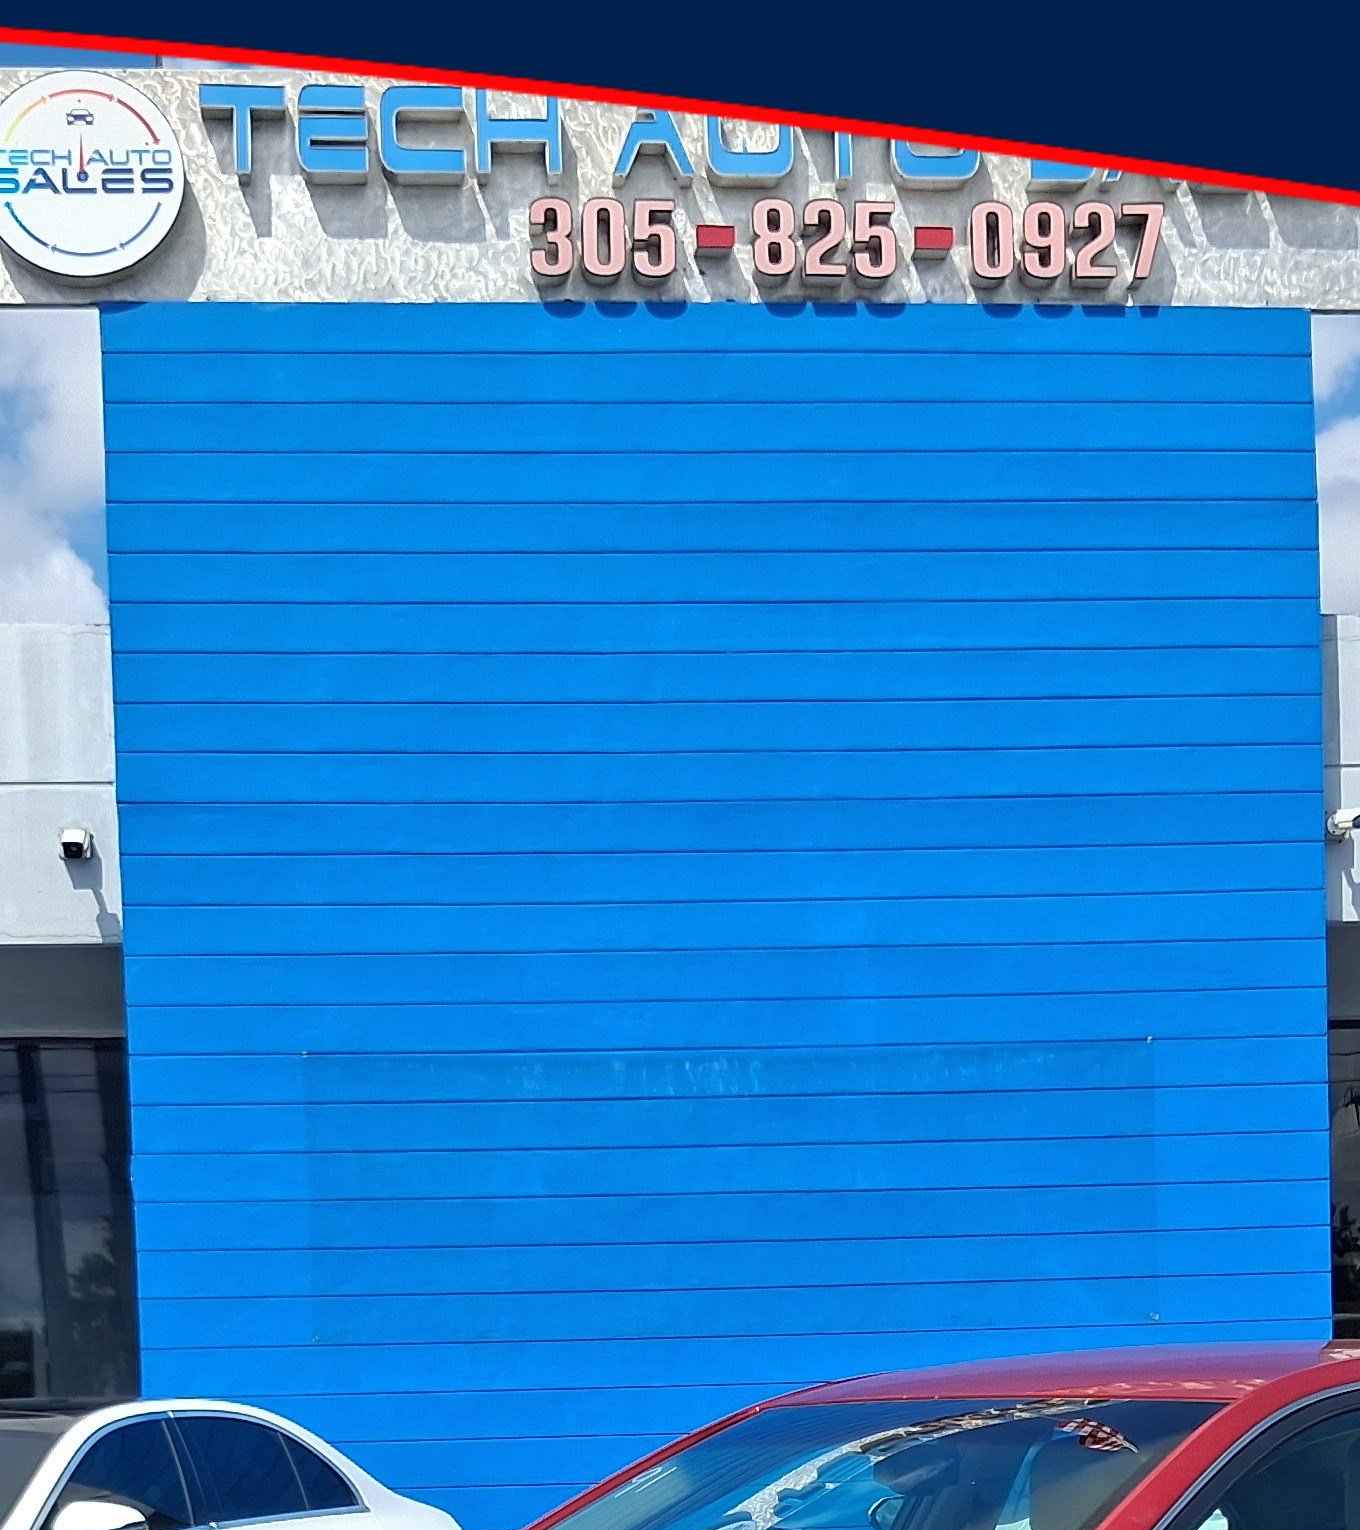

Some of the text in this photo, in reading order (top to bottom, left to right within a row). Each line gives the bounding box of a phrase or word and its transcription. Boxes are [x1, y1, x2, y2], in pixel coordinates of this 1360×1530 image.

[86, 149, 172, 167] AUTO
[199, 84, 562, 180] TECH
[529, 197, 1166, 279] 305-825-0927
